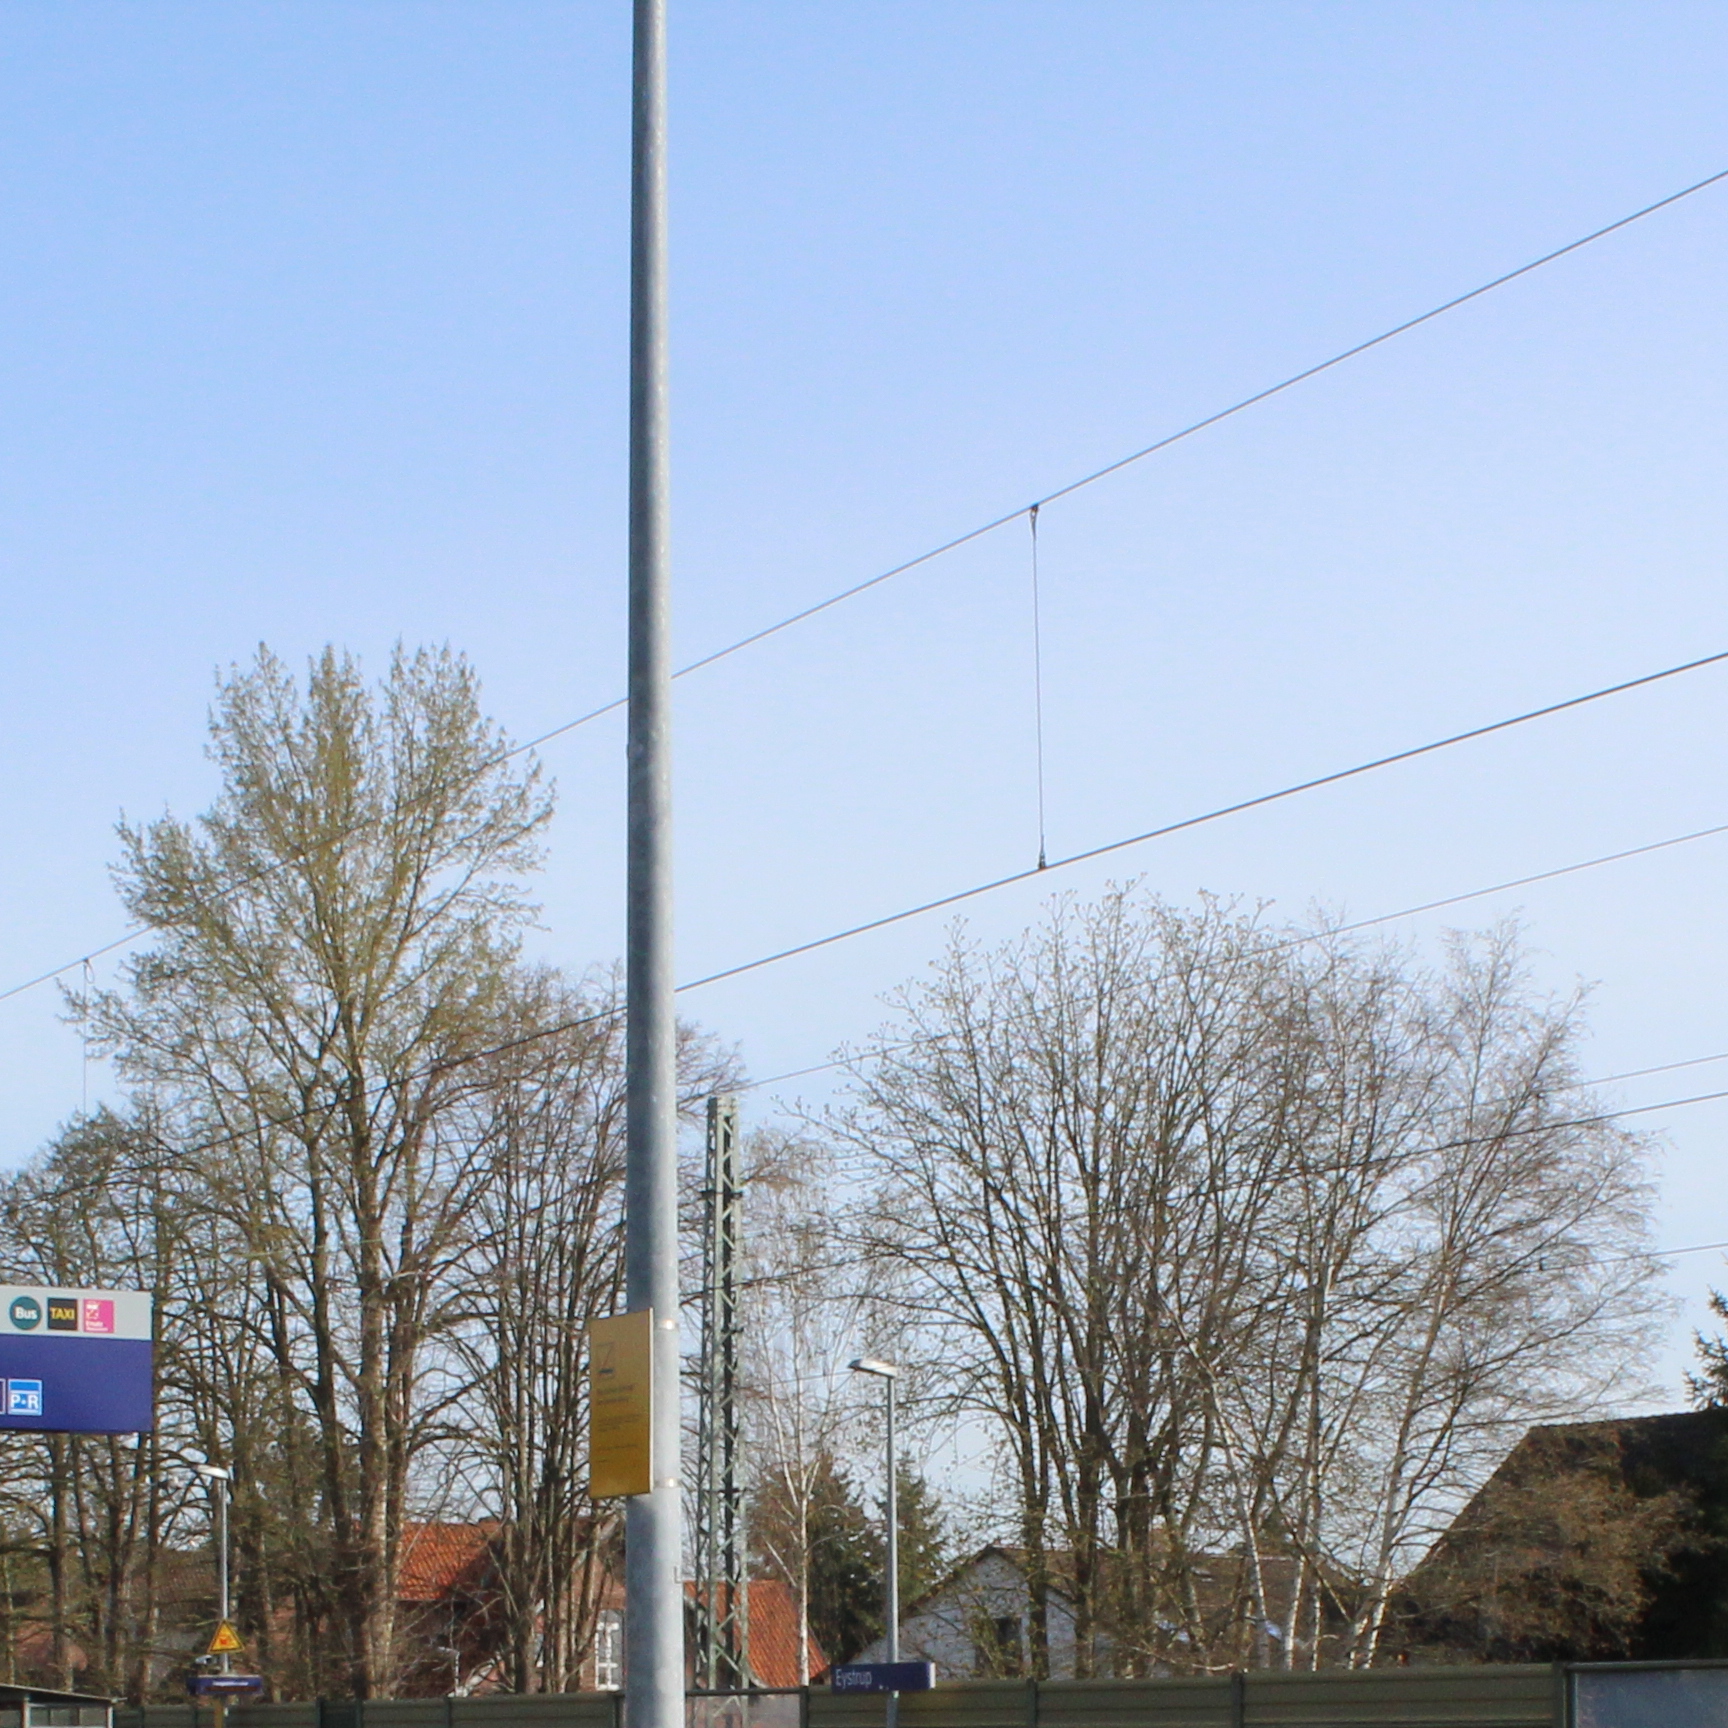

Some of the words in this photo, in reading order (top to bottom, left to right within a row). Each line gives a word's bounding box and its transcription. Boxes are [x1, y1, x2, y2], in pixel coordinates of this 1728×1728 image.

[15, 1306, 38, 1320] Bus
[50, 1307, 76, 1320] TAXI
[835, 1668, 872, 1690] Eystrup
